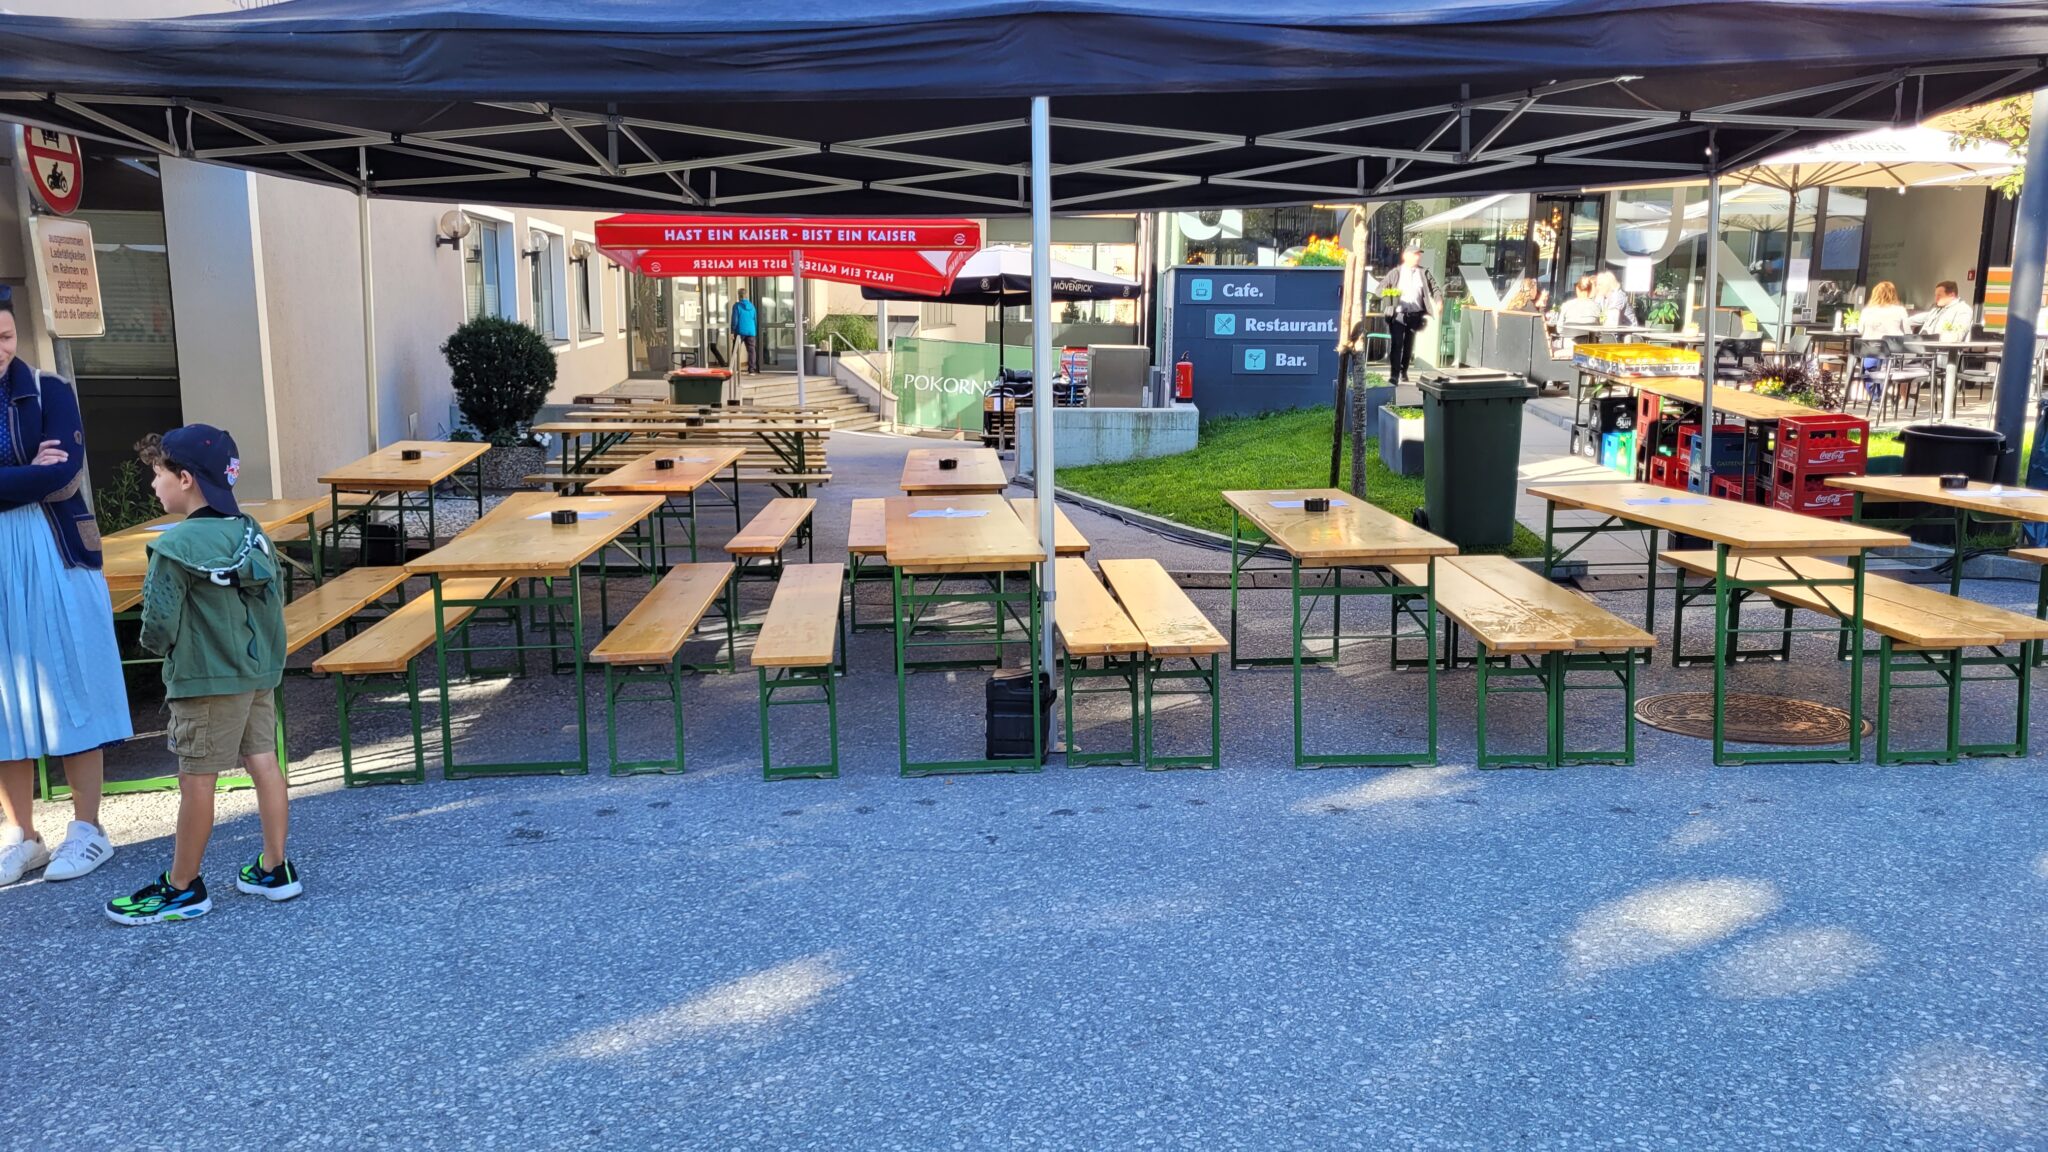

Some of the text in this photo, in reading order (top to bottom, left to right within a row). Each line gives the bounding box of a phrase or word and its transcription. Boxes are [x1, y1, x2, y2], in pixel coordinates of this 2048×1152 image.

[664, 229, 702, 241] HAST
[708, 229, 733, 241] EIN
[739, 229, 789, 241] KAISER
[802, 229, 832, 241] BIST
[838, 230, 862, 241] EIN
[867, 230, 917, 242] KAISER
[1053, 279, 1092, 294] MÖVENPICK
[1222, 283, 1264, 298] Cafe.
[1245, 317, 1338, 332] Restaurant.
[1275, 353, 1307, 367] Bar.
